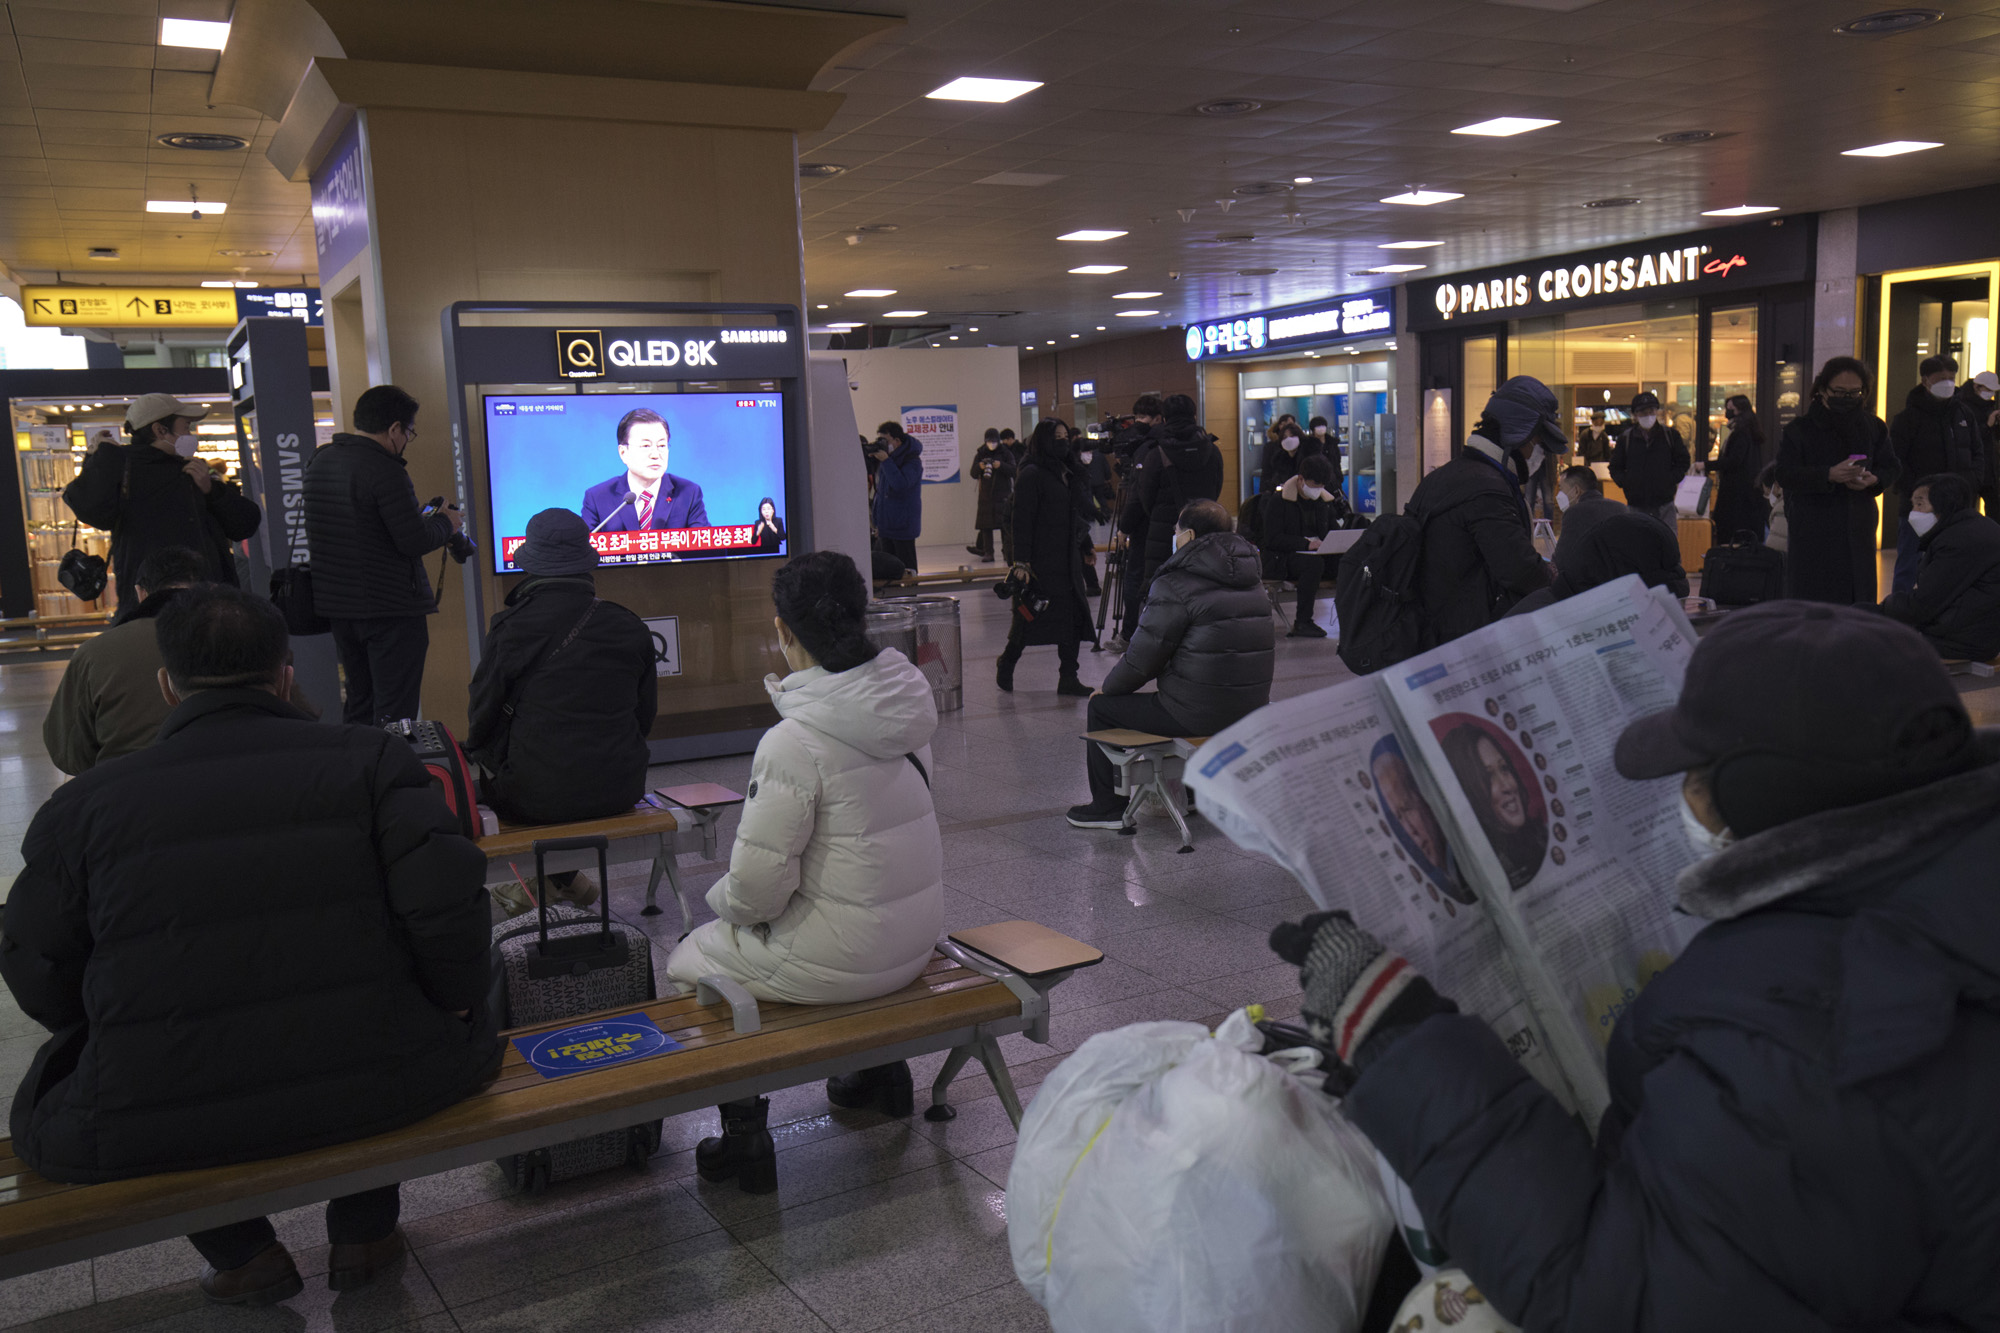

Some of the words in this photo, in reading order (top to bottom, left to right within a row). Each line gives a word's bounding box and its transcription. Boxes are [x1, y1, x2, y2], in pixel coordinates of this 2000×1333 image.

[1461, 275, 1527, 313] PARIS
[1538, 247, 1699, 302] CROISSANT
[158, 301, 168, 312] 3
[721, 330, 787, 343] SAMSUNG
[1204, 317, 1265, 354] 우리은행
[567, 339, 597, 367] Q
[608, 340, 681, 366] QLED
[684, 340, 718, 366] 8K
[757, 399, 776, 408] YTN
[906, 416, 917, 424] 노후
[906, 423, 937, 434] 교체공사
[939, 423, 954, 433] 안내
[277, 433, 311, 564] SAMSUNG
[660, 530, 689, 549] 부족이
[692, 529, 710, 548] 가격
[712, 529, 732, 547] 상승
[733, 527, 752, 544] 초래
[637, 553, 648, 561] 관계
[649, 553, 660, 561] 언급
[627, 948, 637, 998] CAARANY
[637, 945, 648, 996] CAARANY
[586, 983, 626, 996] CAARANY
[547, 1033, 642, 1059] 주세요!
[575, 1043, 633, 1061] 비워
